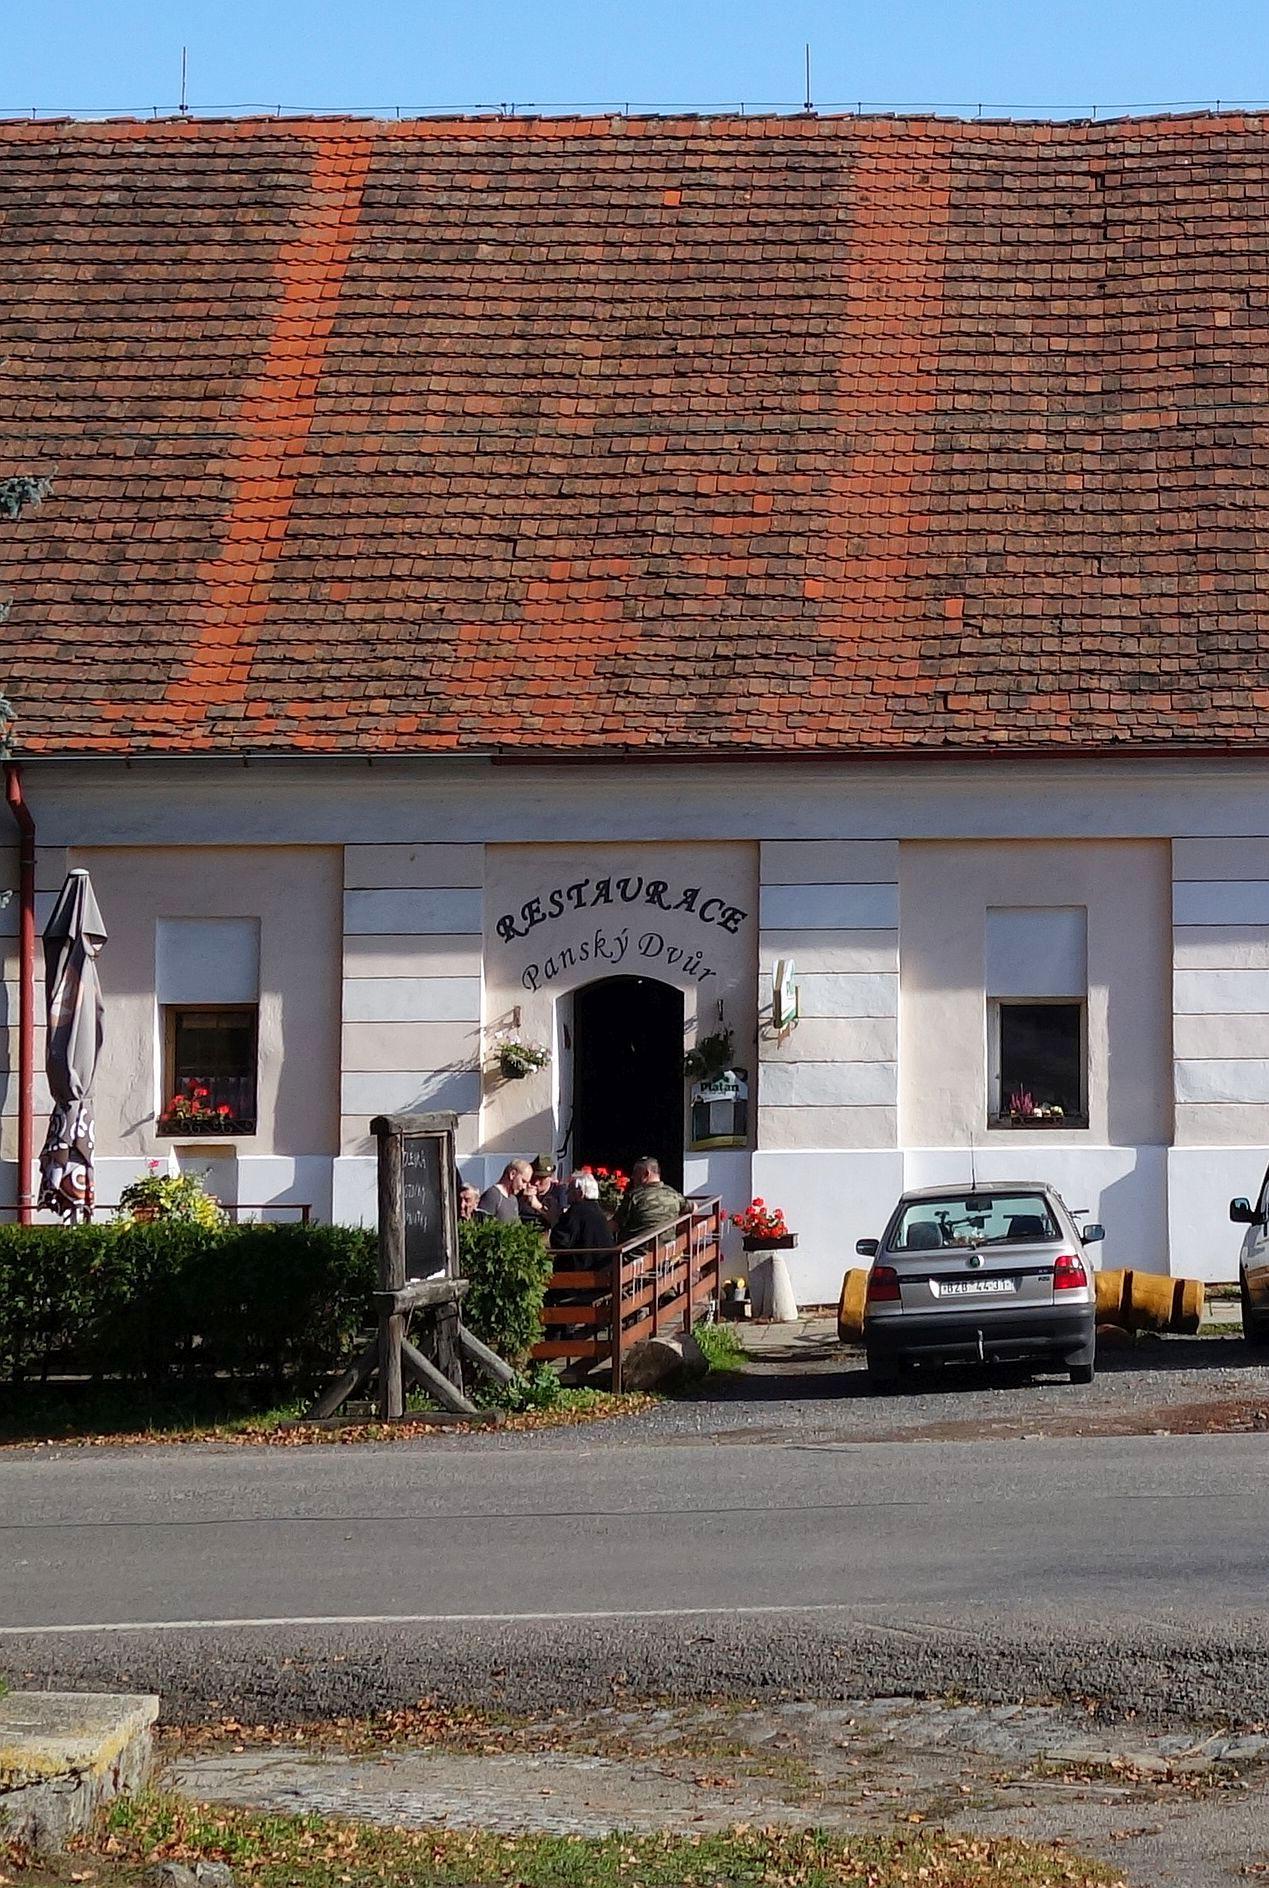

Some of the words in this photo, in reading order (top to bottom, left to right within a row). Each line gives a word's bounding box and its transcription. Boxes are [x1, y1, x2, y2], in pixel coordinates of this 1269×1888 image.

[496, 876, 748, 944] RESTAURACE
[521, 928, 629, 993] Panský
[638, 932, 717, 982] Dvůr
[701, 1082, 739, 1091] Platan
